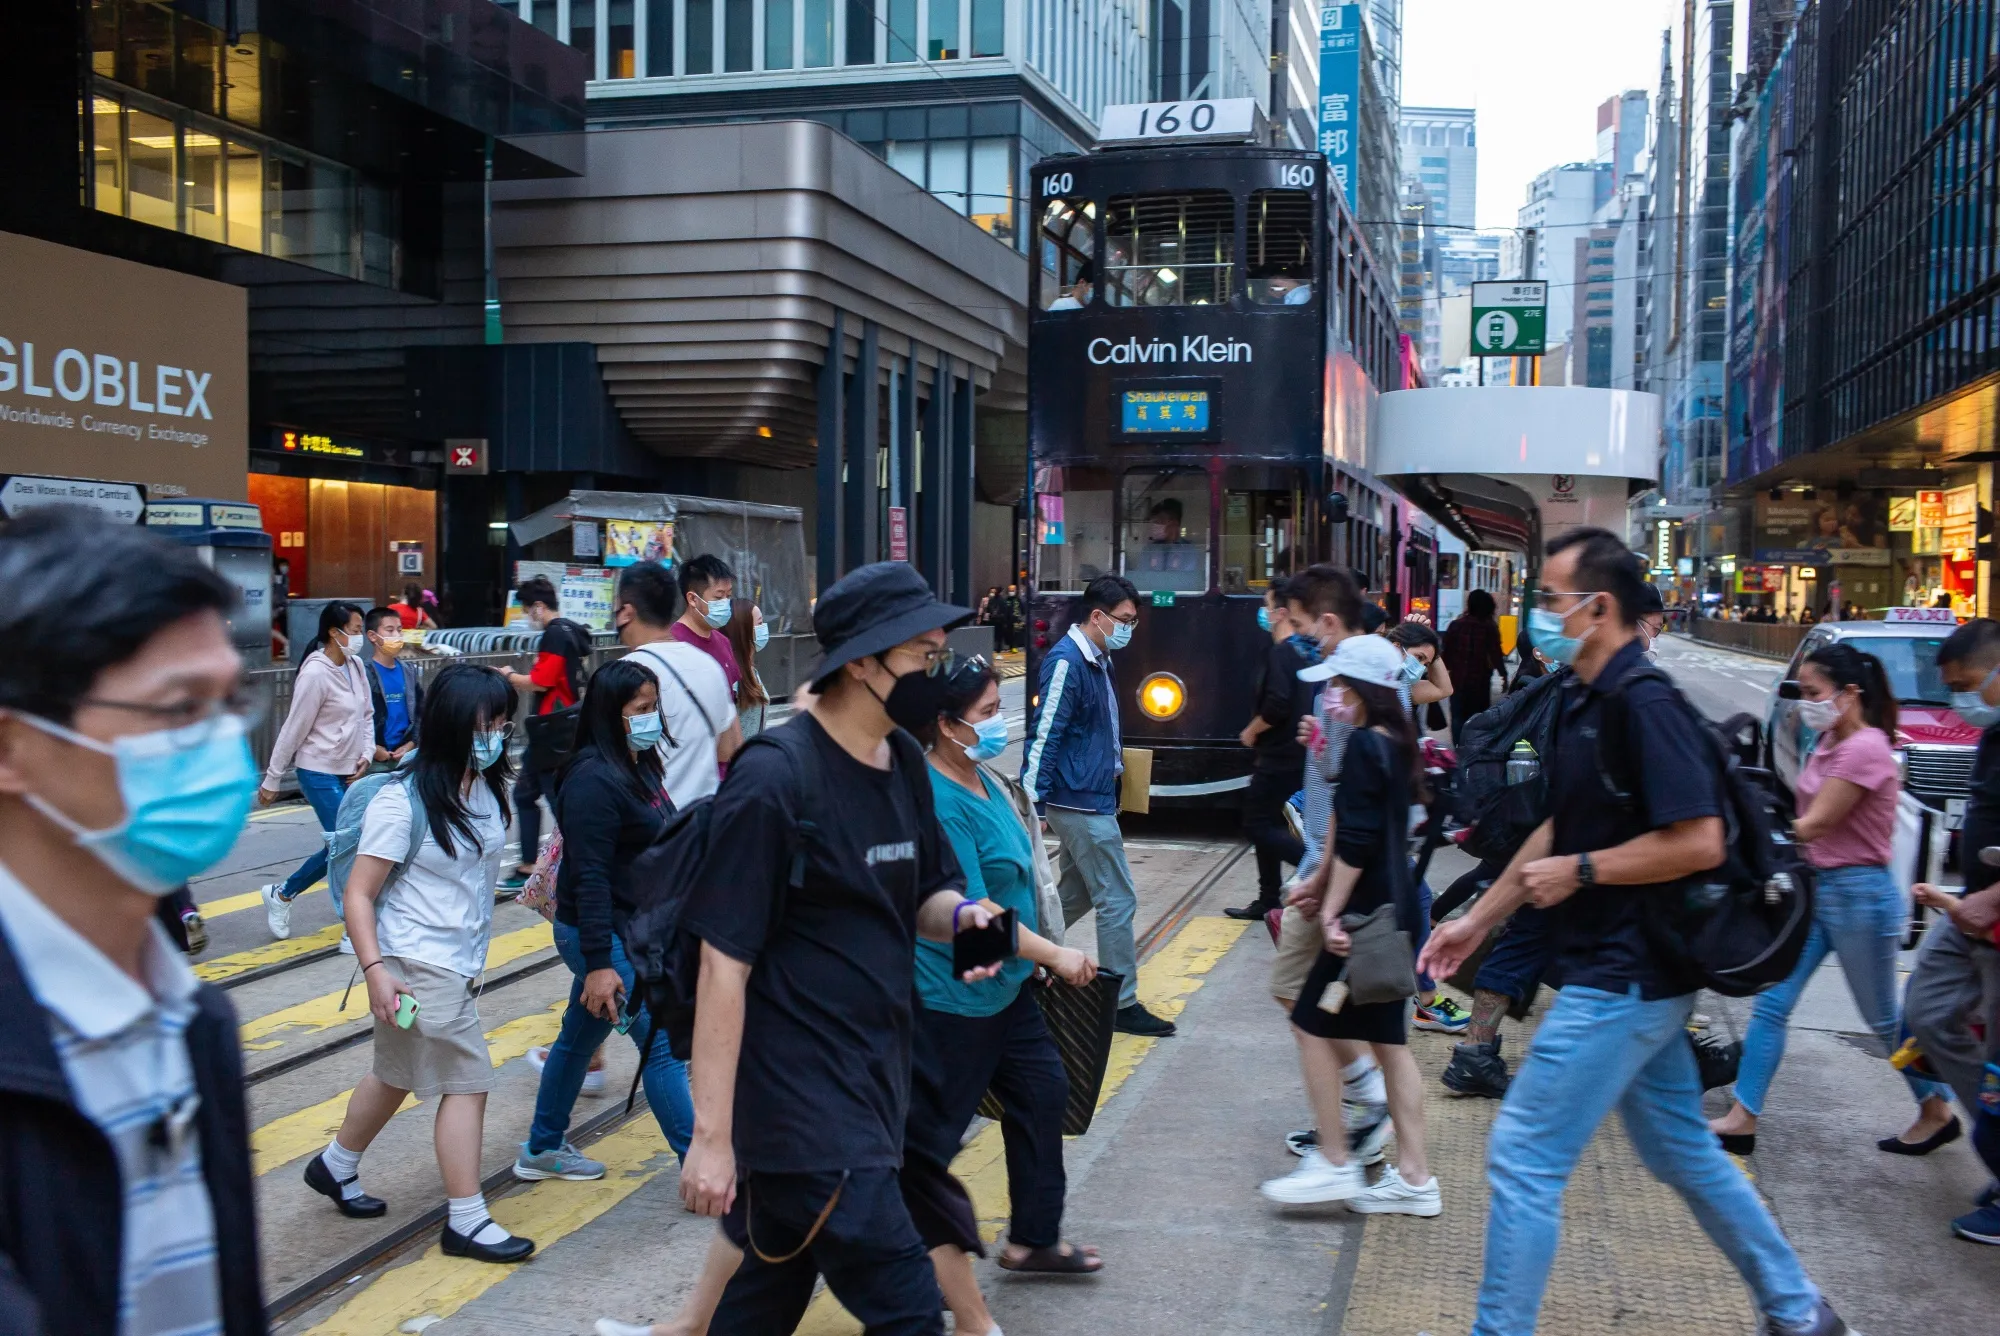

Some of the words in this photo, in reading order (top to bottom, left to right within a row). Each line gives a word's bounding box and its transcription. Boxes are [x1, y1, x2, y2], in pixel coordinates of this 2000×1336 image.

[1139, 103, 1215, 136] 160
[1042, 172, 1074, 197] 160
[1281, 164, 1315, 188] 160
[1087, 335, 1178, 365] Calvin
[1182, 334, 1252, 363] Klein
[0, 336, 213, 420] GLOBLEX
[1126, 390, 1209, 403] Shaukeiwan
[0, 404, 75, 430] Worldwide
[80, 414, 144, 442] Currency
[148, 423, 209, 449] Exchange
[14, 482, 35, 495] Des
[36, 483, 67, 497] Voeux
[69, 486, 95, 499] Road
[97, 488, 132, 501] Central
[1895, 608, 1949, 622] TAXI
